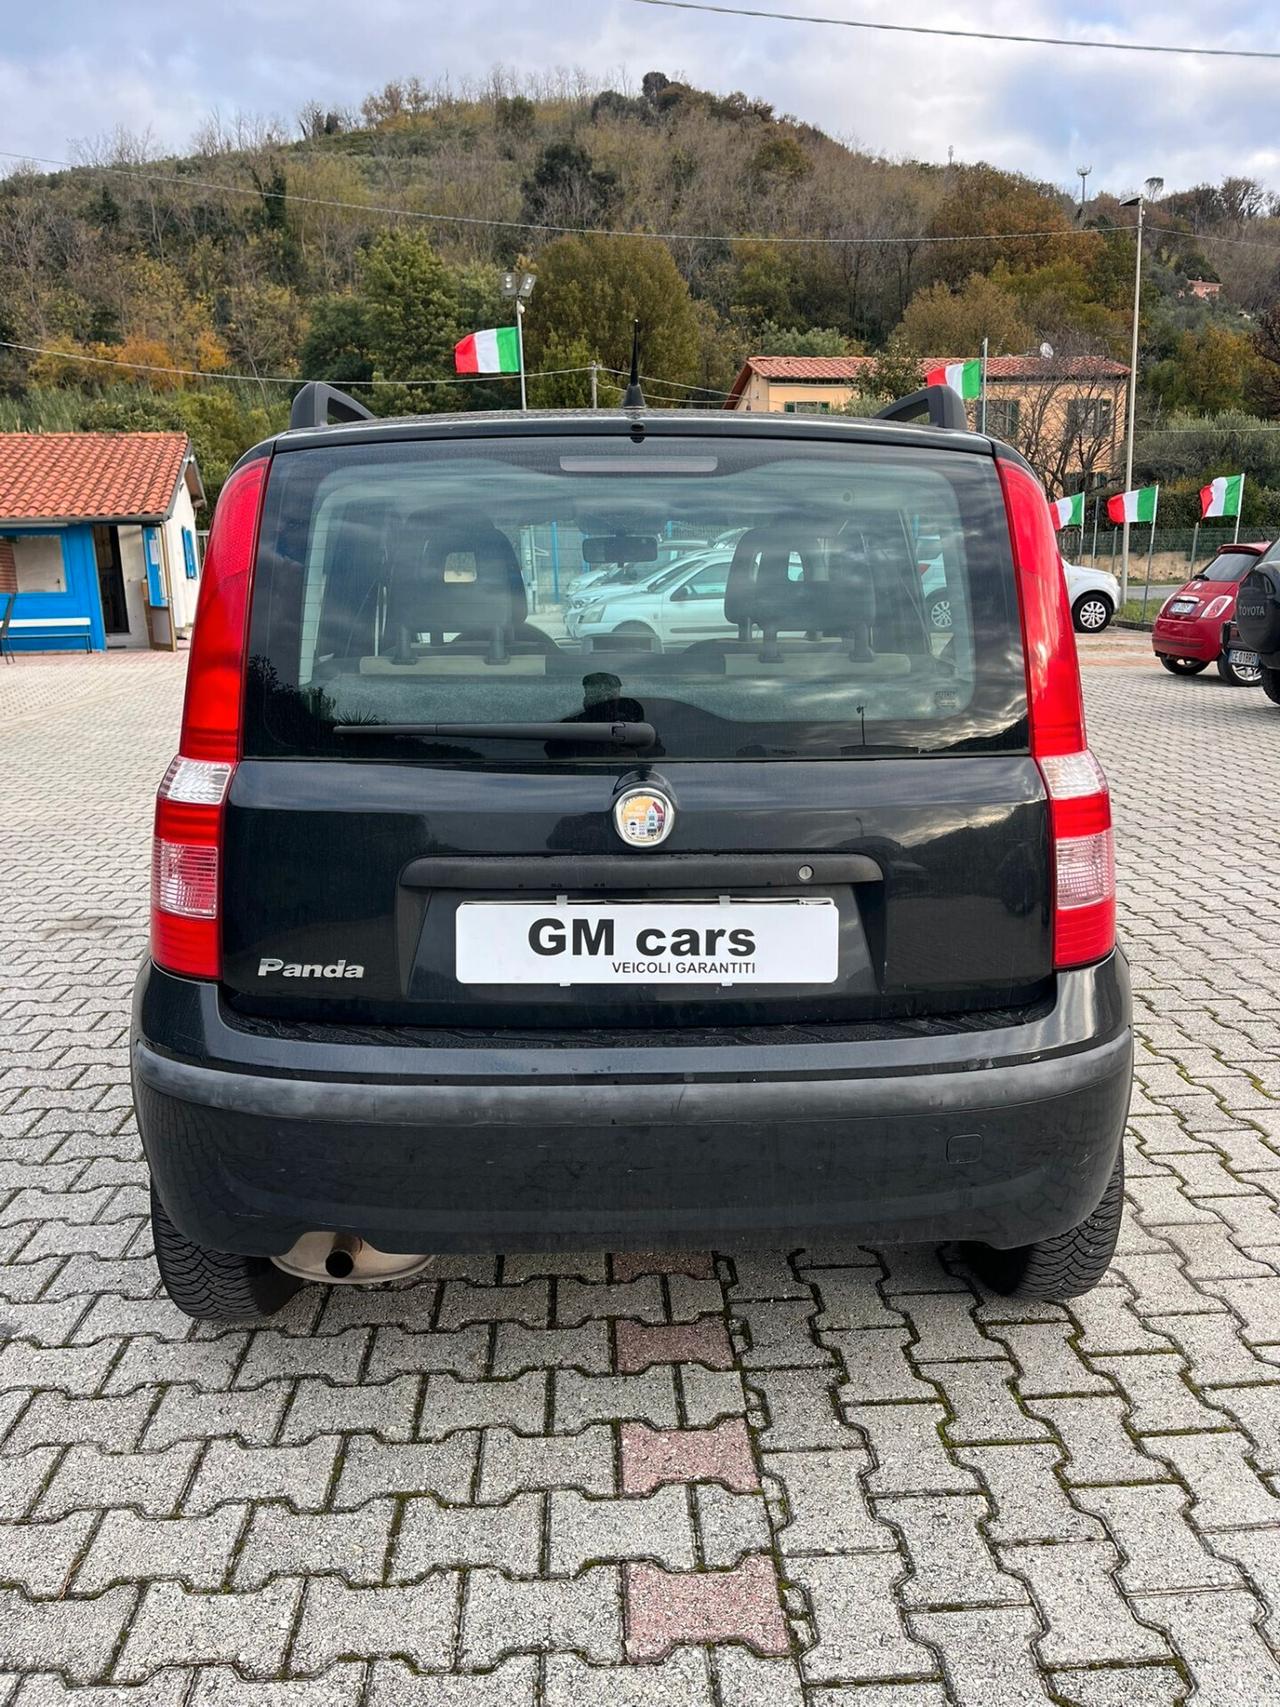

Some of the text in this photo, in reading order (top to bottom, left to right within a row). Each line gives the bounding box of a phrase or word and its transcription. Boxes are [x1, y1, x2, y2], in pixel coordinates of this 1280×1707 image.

[1239, 605, 1265, 616] TOYOTA
[527, 917, 756, 957] GM cars
[257, 958, 365, 978] Panda
[612, 961, 756, 974] VEICOLI GARANTITI
